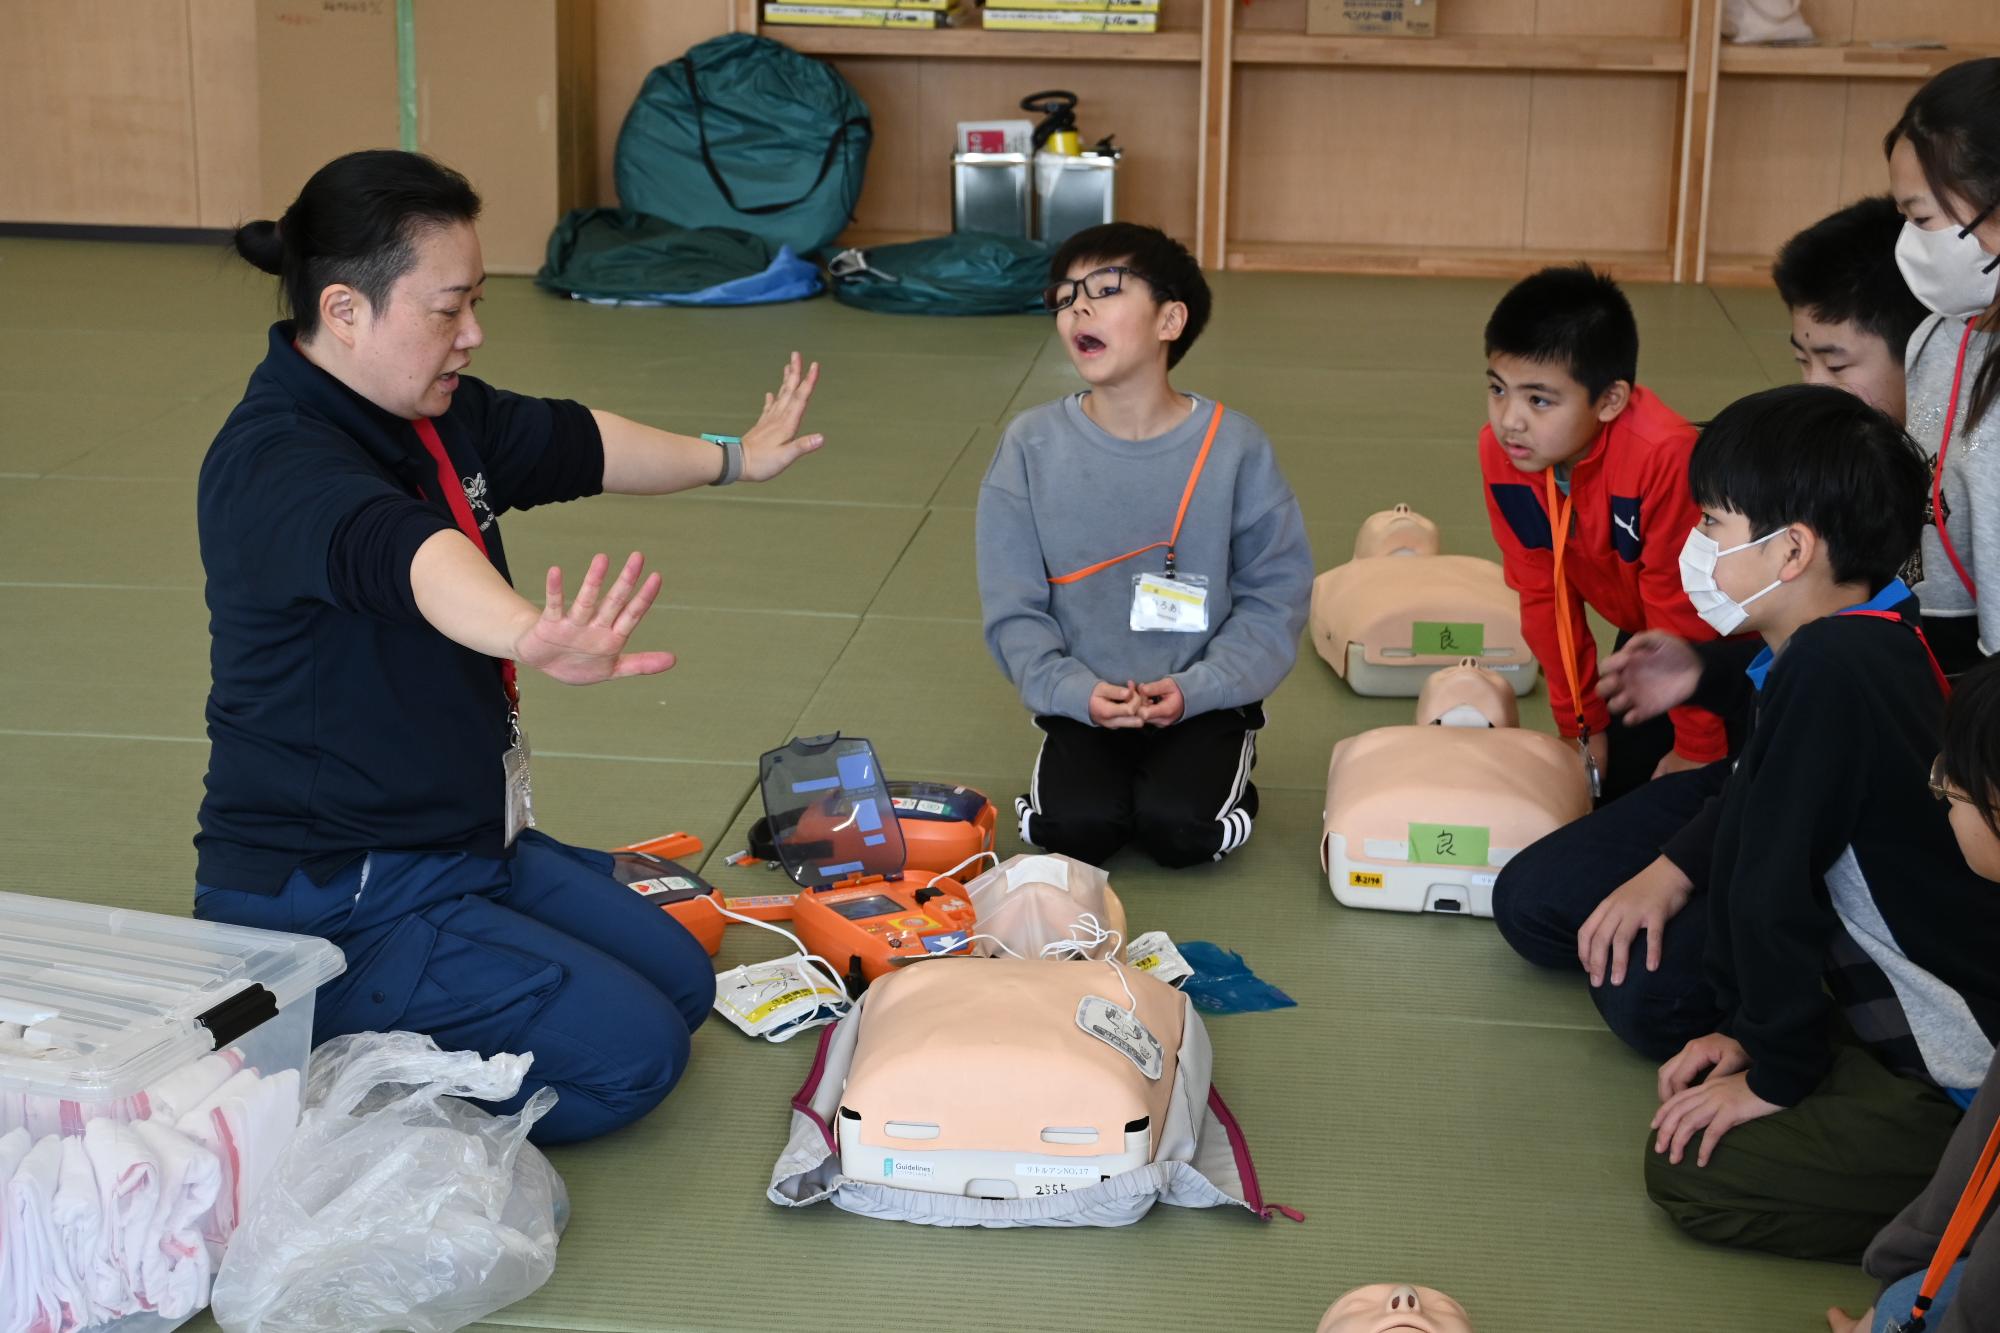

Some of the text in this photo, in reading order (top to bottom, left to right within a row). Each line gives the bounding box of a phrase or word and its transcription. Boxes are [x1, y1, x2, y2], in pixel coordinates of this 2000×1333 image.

[1440, 626, 1459, 650] 良
[1437, 829, 1457, 856] 良
[895, 1162, 931, 1173] Guidelines
